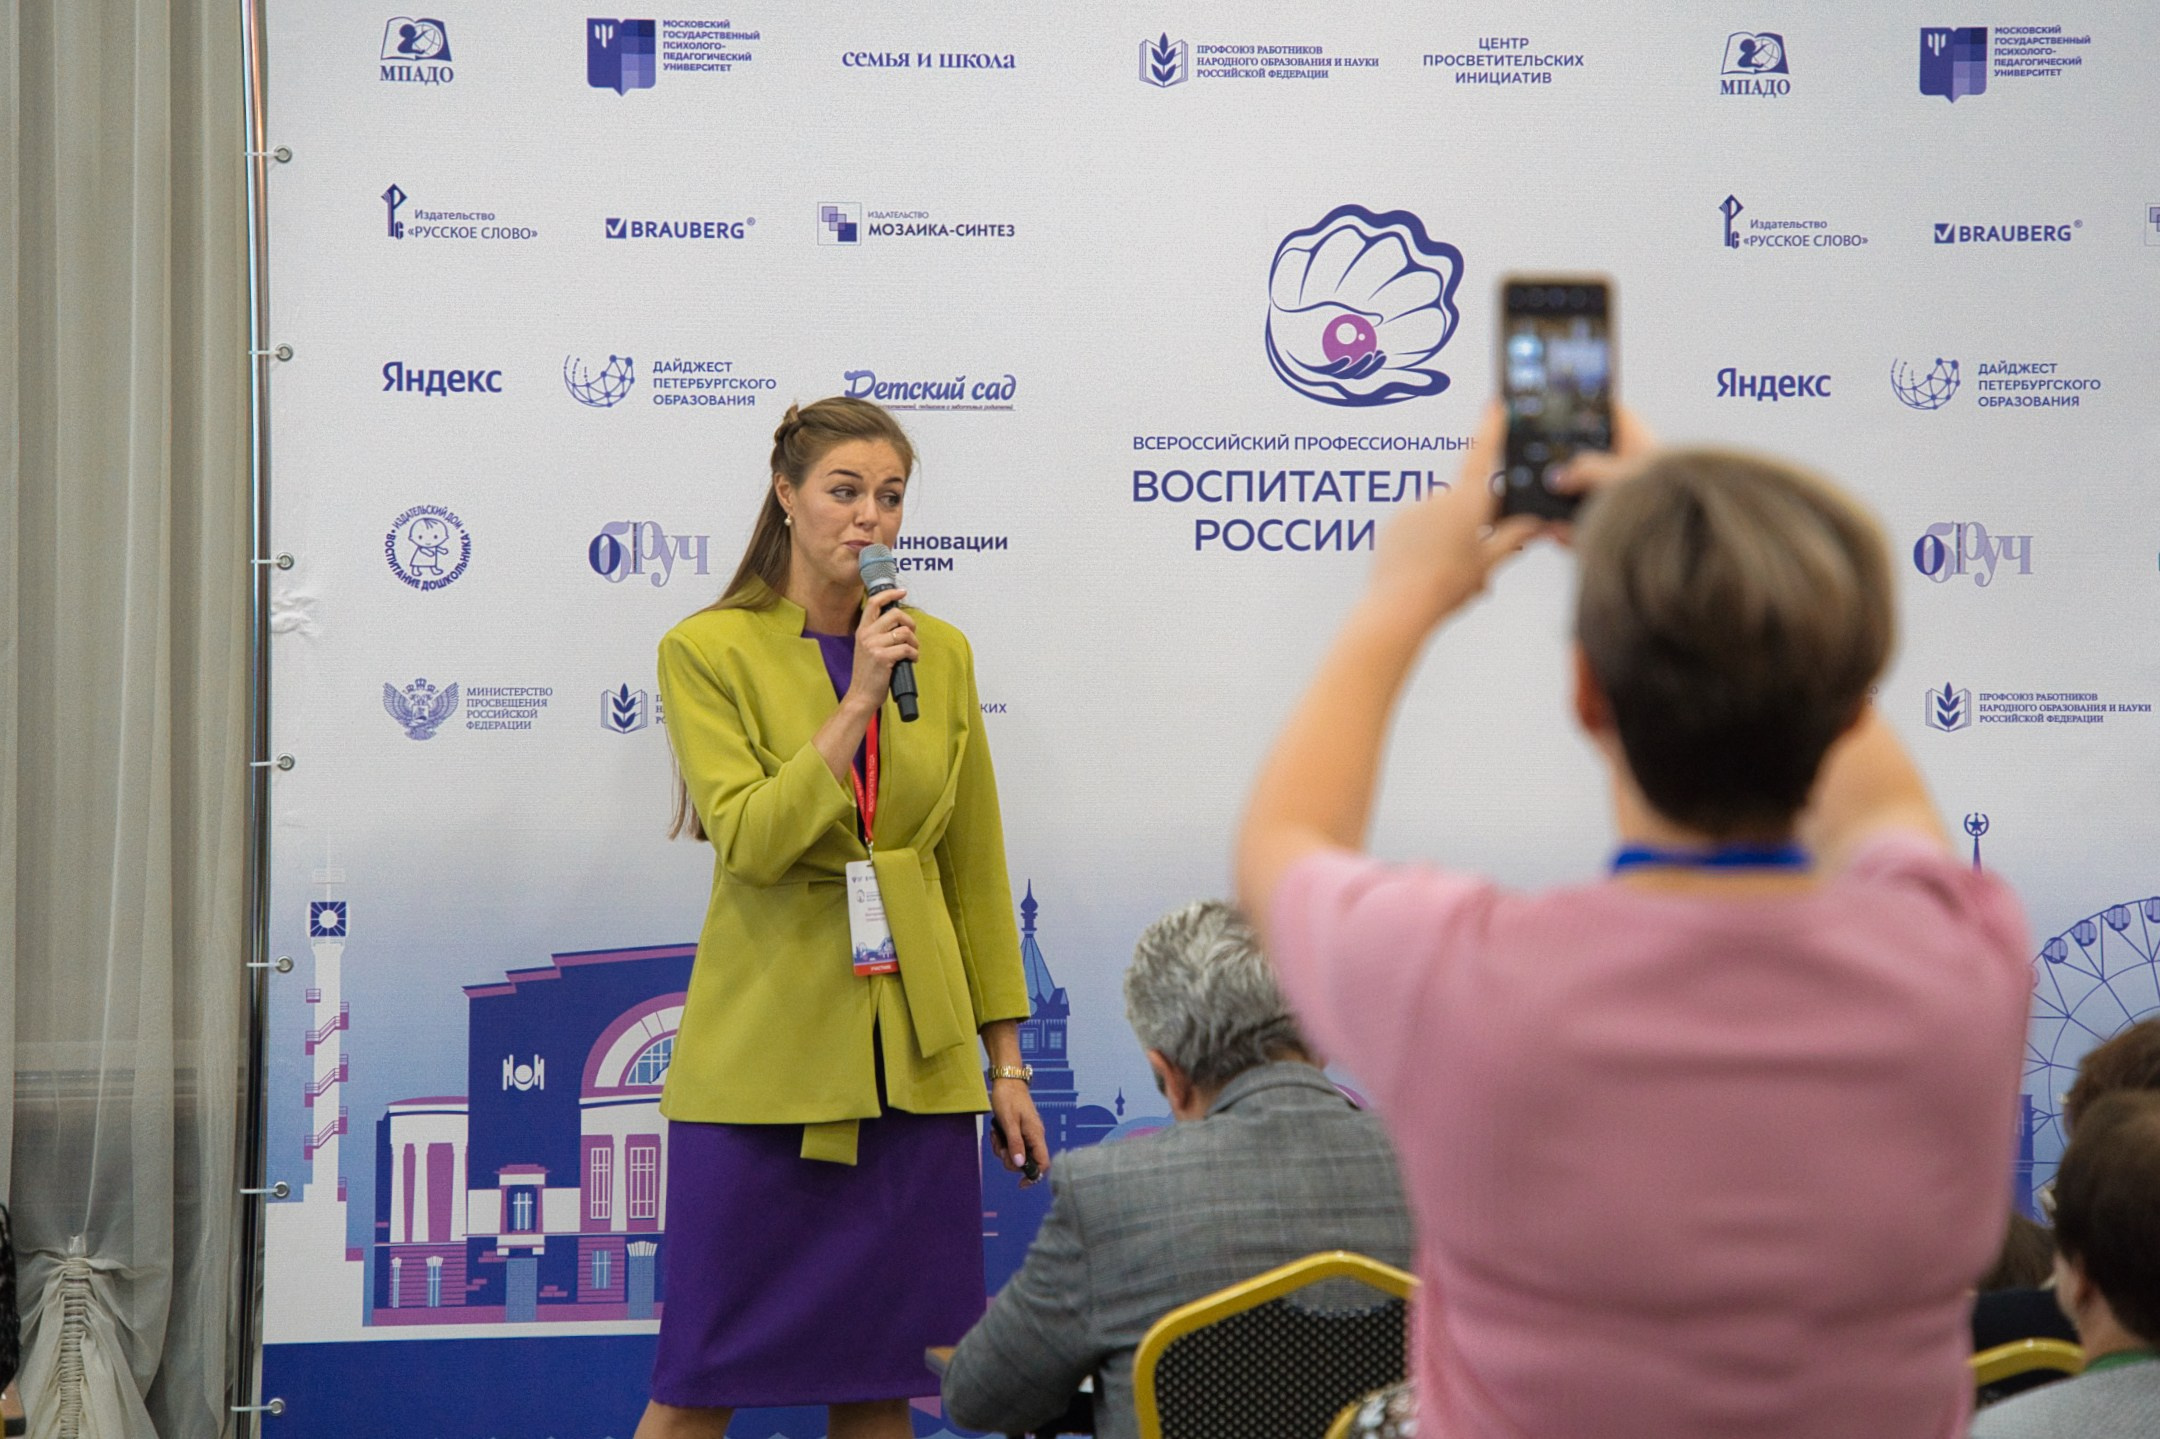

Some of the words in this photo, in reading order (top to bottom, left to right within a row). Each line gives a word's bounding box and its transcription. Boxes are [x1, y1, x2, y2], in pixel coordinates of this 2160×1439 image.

[663, 19, 730, 28] МОСКОВСКИЙ
[1995, 25, 2061, 34] МОСКОВСКИЙ
[663, 31, 760, 40] ГОСУДАРСТВЕННЫЙ
[1995, 35, 2091, 46] ГОСУДАРСТВЕННЫЙ
[663, 41, 726, 50] ПСИХОЛОГО-
[1197, 45, 1255, 54] ПРОФСОЮЗ
[1257, 46, 1323, 54] РАБОТНИКОВ
[1479, 38, 1529, 51] ЦЕНТР
[663, 52, 752, 61] ПЕДАГОГИЧЕСКИЙ
[1994, 48, 2056, 56] ПСИХОЛОГО-
[918, 53, 931, 67] и
[1197, 57, 1258, 67] НАРОДНОГО
[1261, 58, 1332, 66] ОБРАЗОВАНИЯ
[1335, 58, 1342, 66] И
[1344, 58, 1379, 66] НАУКИ
[1424, 55, 1584, 66] ПРОСВЕТИТЕЛЬСКИХ
[1994, 56, 2082, 67] ПЕДАГОГИЧЕСКИЙ
[663, 63, 732, 71] УНИВЕРСИТЕТ
[380, 65, 454, 85] МПАДО
[1197, 68, 1265, 78] РОССИЙСКОЙ
[1268, 70, 1328, 79] ФЕДЕРАЦИИ
[1456, 72, 1552, 85] ИНИЦИАТИВ
[1720, 79, 1790, 98] МПАДО
[415, 210, 495, 221] Издательство
[868, 211, 929, 219] ИЗДАТЕЛЬСТВО
[1750, 219, 1827, 230] Издательство
[408, 226, 477, 238] «РУССКОЕ
[481, 227, 538, 239] СЛОВО»
[1744, 235, 1810, 247] «РУССКОЕ
[1813, 235, 1868, 246] СЛОВО»
[653, 358, 732, 374] ДАЙДЖЕСТ
[1978, 360, 2058, 375] ДАЙДЖЕСТ
[383, 362, 502, 396] Яндекс
[654, 378, 776, 389] ПЕТЕРБУРГСКОГО
[1717, 368, 1831, 401] Яндекс
[1979, 379, 2101, 390] ПЕТЕРБУРГСКОГО
[844, 369, 967, 401] Детский
[971, 374, 1017, 401] сад
[653, 395, 755, 405] ОБРАЗОВАНИЯ
[1978, 396, 2079, 407] ОБРАЗОВАНИЯ
[1134, 434, 1289, 450] ВСЕРОССИЙСКИЙ
[1294, 436, 1478, 450] ПРОФЕССИОНАЛЬН
[392, 504, 448, 529] ИЗДАТЕЛЬСКИЙ
[445, 512, 464, 530] ДОМ
[1196, 519, 1375, 551] РОССИИ
[384, 533, 421, 589] ВОСПИТАНИЕ
[420, 533, 472, 592] ДОШКОЛЬНИКА
[467, 688, 553, 696] МИНИСТЕРСТВО
[1979, 693, 2034, 701] ПРОФСОЮЗ
[2036, 693, 2098, 701] РАБОТНИКОВ
[467, 699, 547, 708] ПРОСВЕЩЕНИЯ
[1980, 704, 2037, 713] НАРОДНОГО
[2039, 704, 2107, 712] ОБРАЗОВАНИЯ
[2118, 704, 2151, 712] НАУКИ
[467, 709, 538, 718] РОССИЙСКОЙ
[1980, 714, 2044, 722] РОССИЙСКОЙ
[2046, 715, 2103, 724] ФЕДЕРАЦИИ
[466, 721, 531, 730] ФЕДЕРАЦИИ
